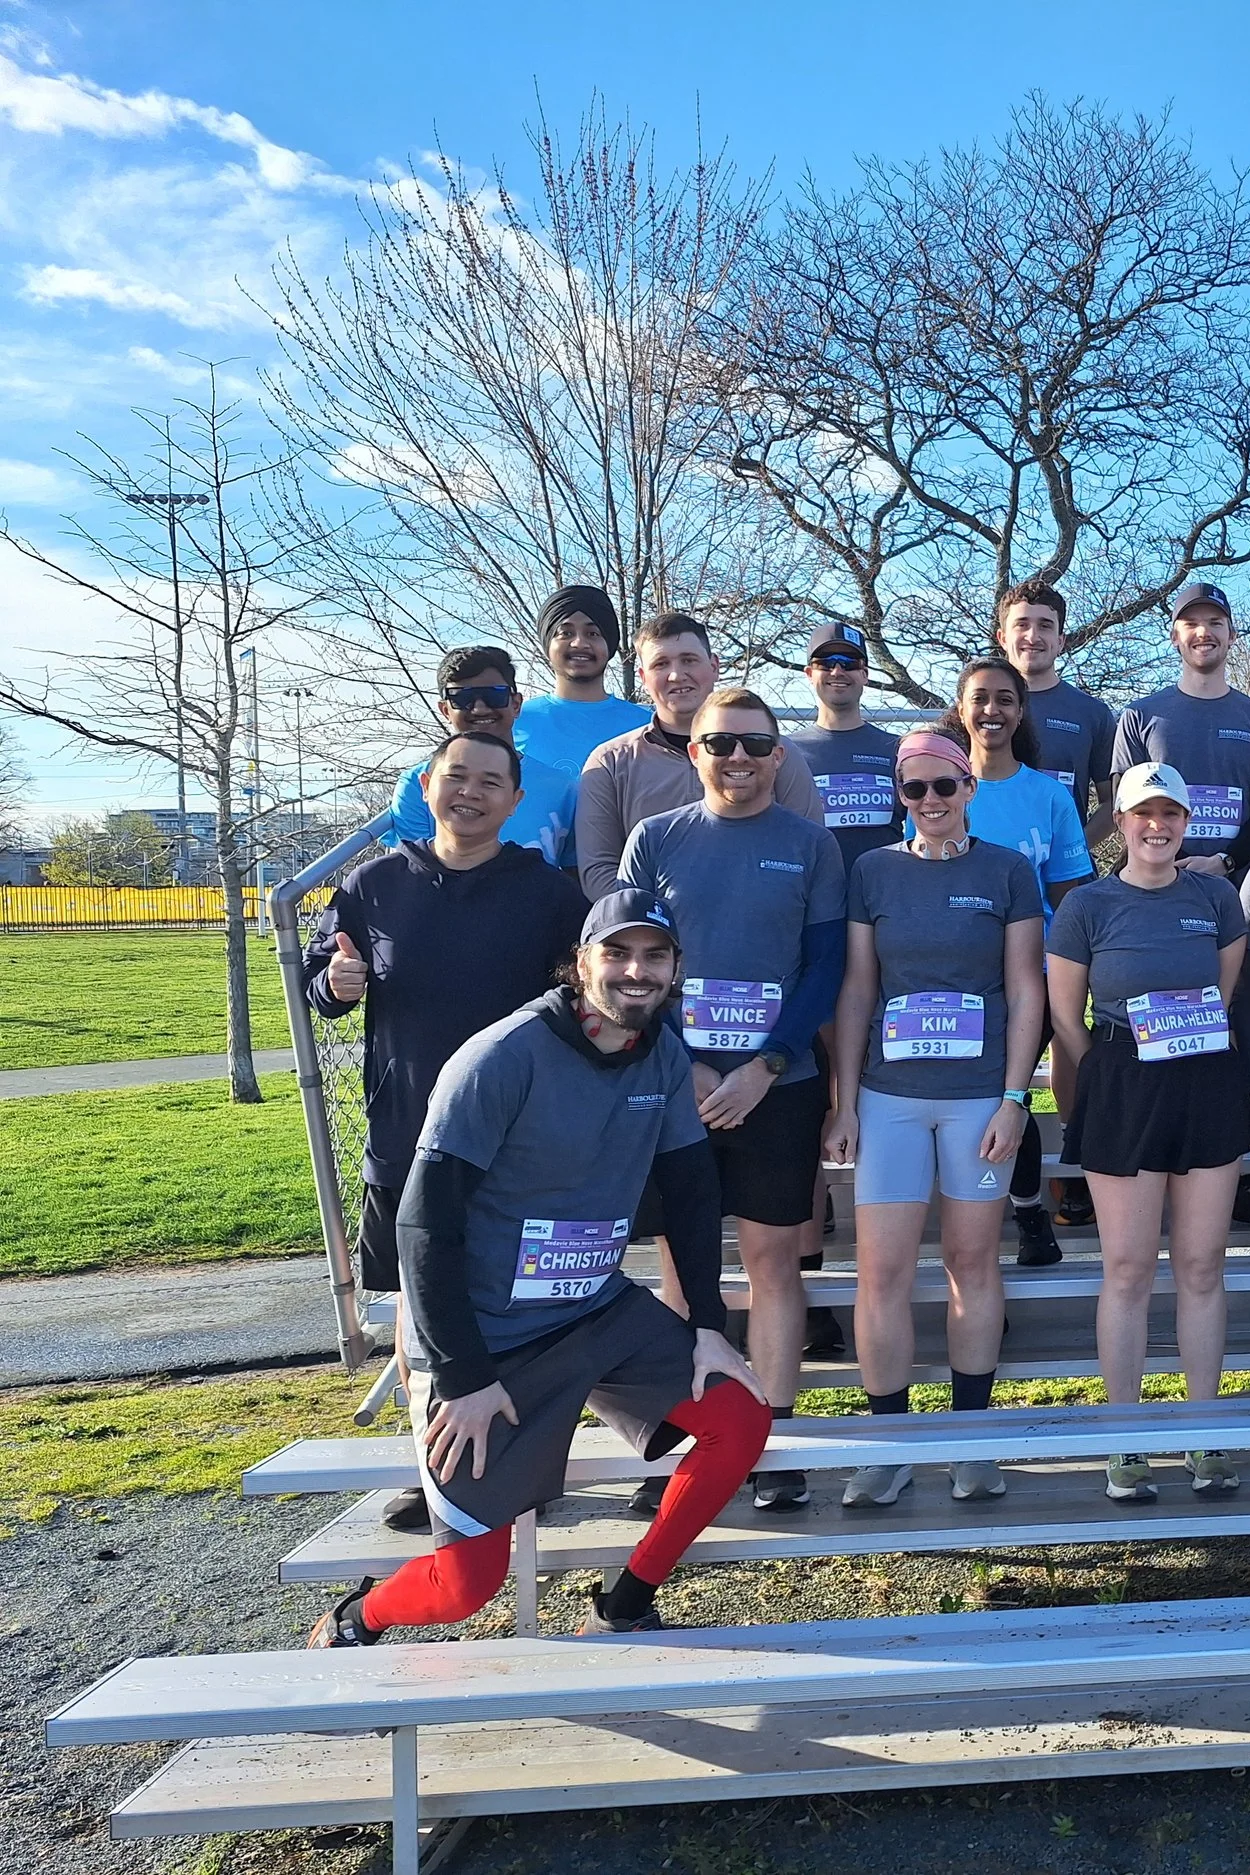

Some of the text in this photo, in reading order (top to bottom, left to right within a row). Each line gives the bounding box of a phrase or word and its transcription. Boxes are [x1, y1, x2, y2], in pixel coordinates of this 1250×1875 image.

[827, 793, 892, 806] GORDON
[840, 813, 870, 824] 6021
[1192, 805, 1239, 819] ARSON
[1191, 826, 1221, 836] 5873
[1064, 846, 1084, 858] BLUE
[709, 1006, 766, 1024] VINCE
[1147, 1008, 1226, 1034] LAURA-HÉLÈNE
[922, 1017, 957, 1031] KIM
[708, 1033, 749, 1047] 5872
[1167, 1037, 1205, 1054] 6047
[911, 1042, 948, 1054] 5931
[539, 1248, 622, 1270] CHRISTIAN
[550, 1280, 591, 1296] 5870
